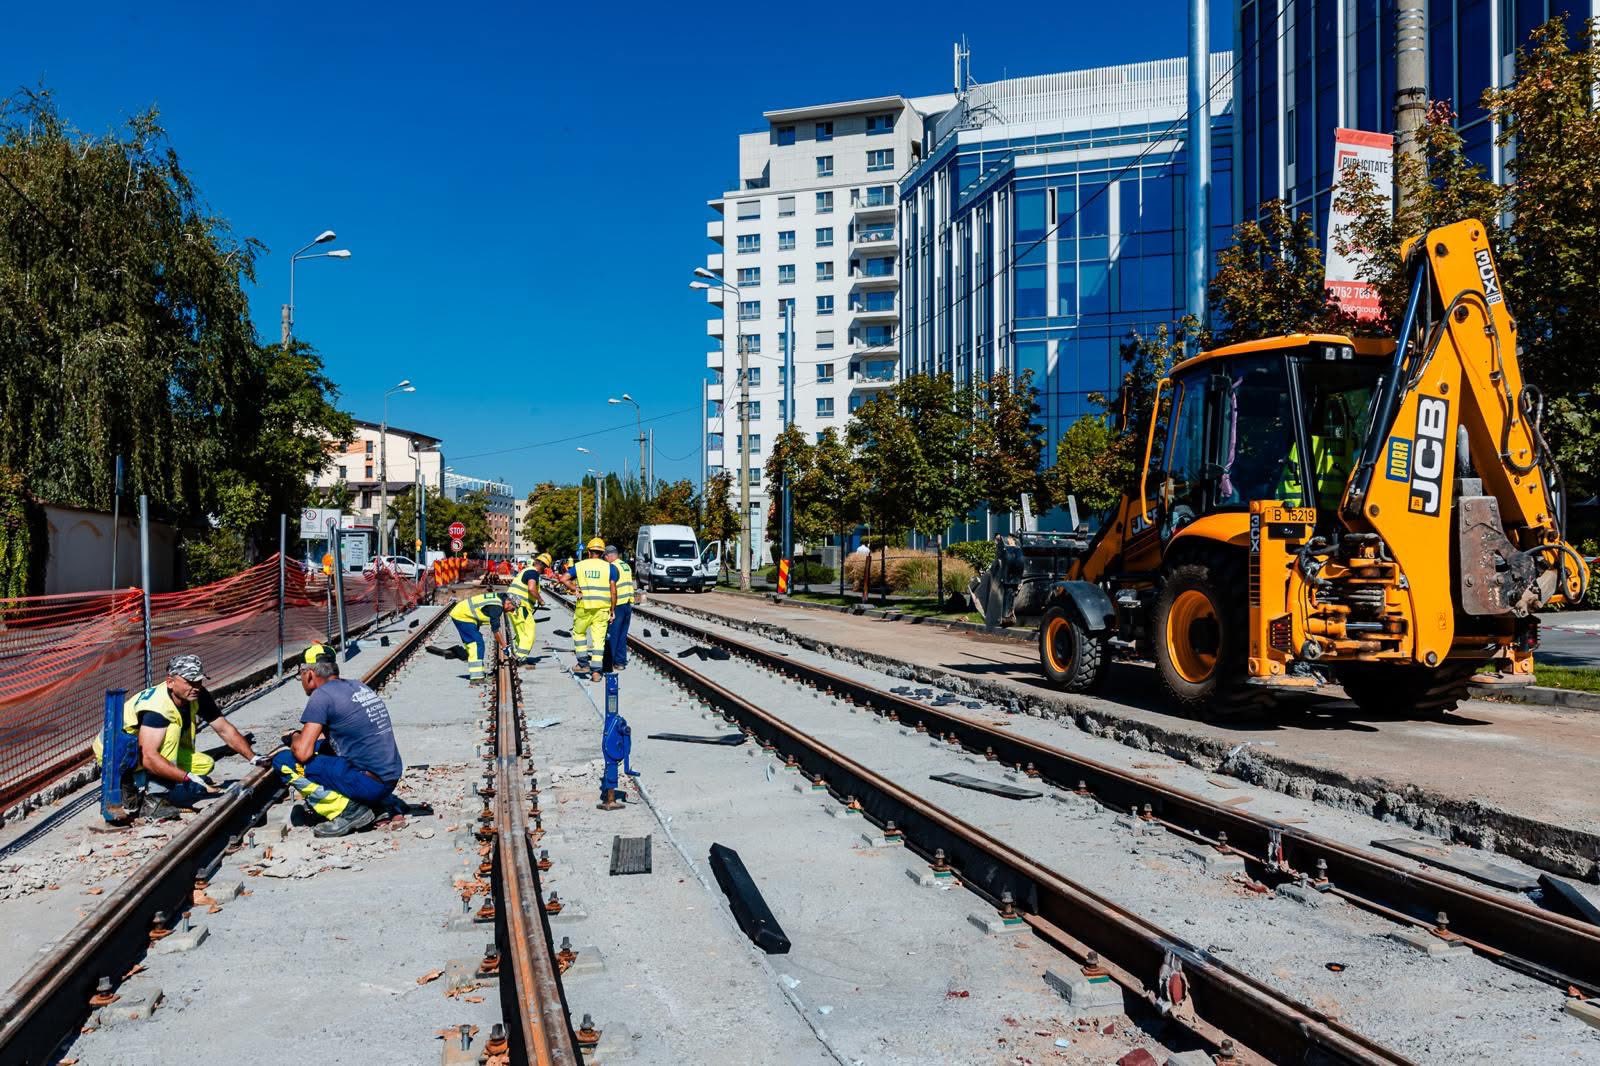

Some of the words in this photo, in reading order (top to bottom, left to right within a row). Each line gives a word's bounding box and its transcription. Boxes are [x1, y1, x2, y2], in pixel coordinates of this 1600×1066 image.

[1475, 249, 1499, 295] 3CX
[1390, 441, 1409, 478] PORR
[1413, 398, 1447, 513] JCB
[449, 527, 465, 535] STOP
[1251, 515, 1260, 552] 3CX
[1274, 509, 1282, 521] B
[1288, 509, 1315, 522] 15219
